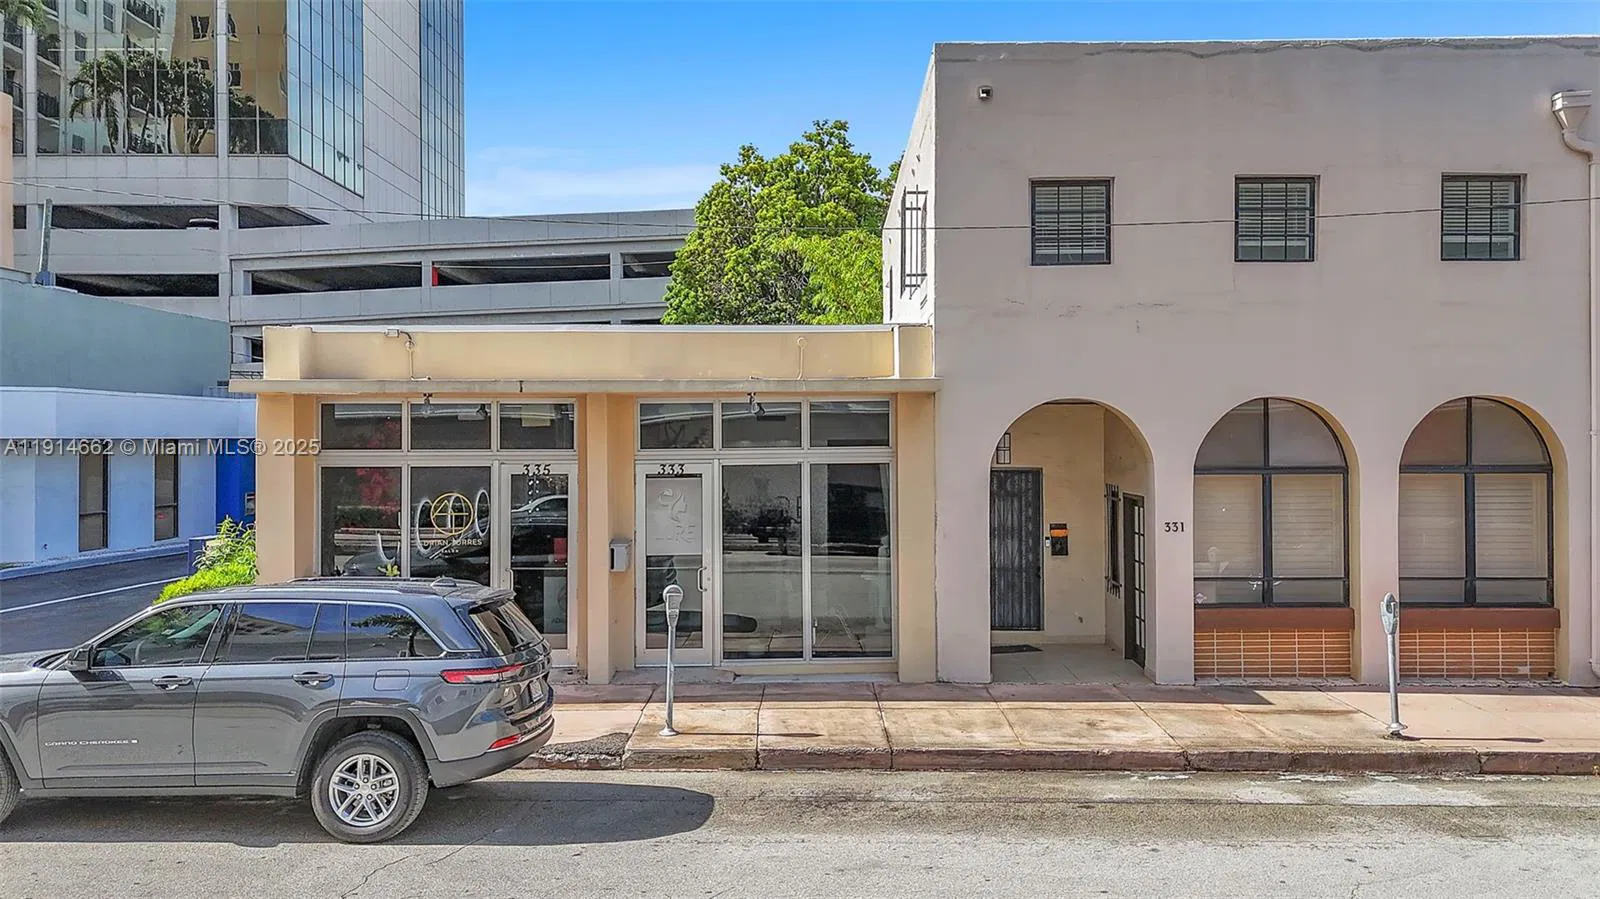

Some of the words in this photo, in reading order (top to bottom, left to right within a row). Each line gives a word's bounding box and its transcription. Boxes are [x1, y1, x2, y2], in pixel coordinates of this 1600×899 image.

[523, 464, 551, 476] 335
[658, 464, 685, 475] 333
[1164, 522, 1185, 532] 331
